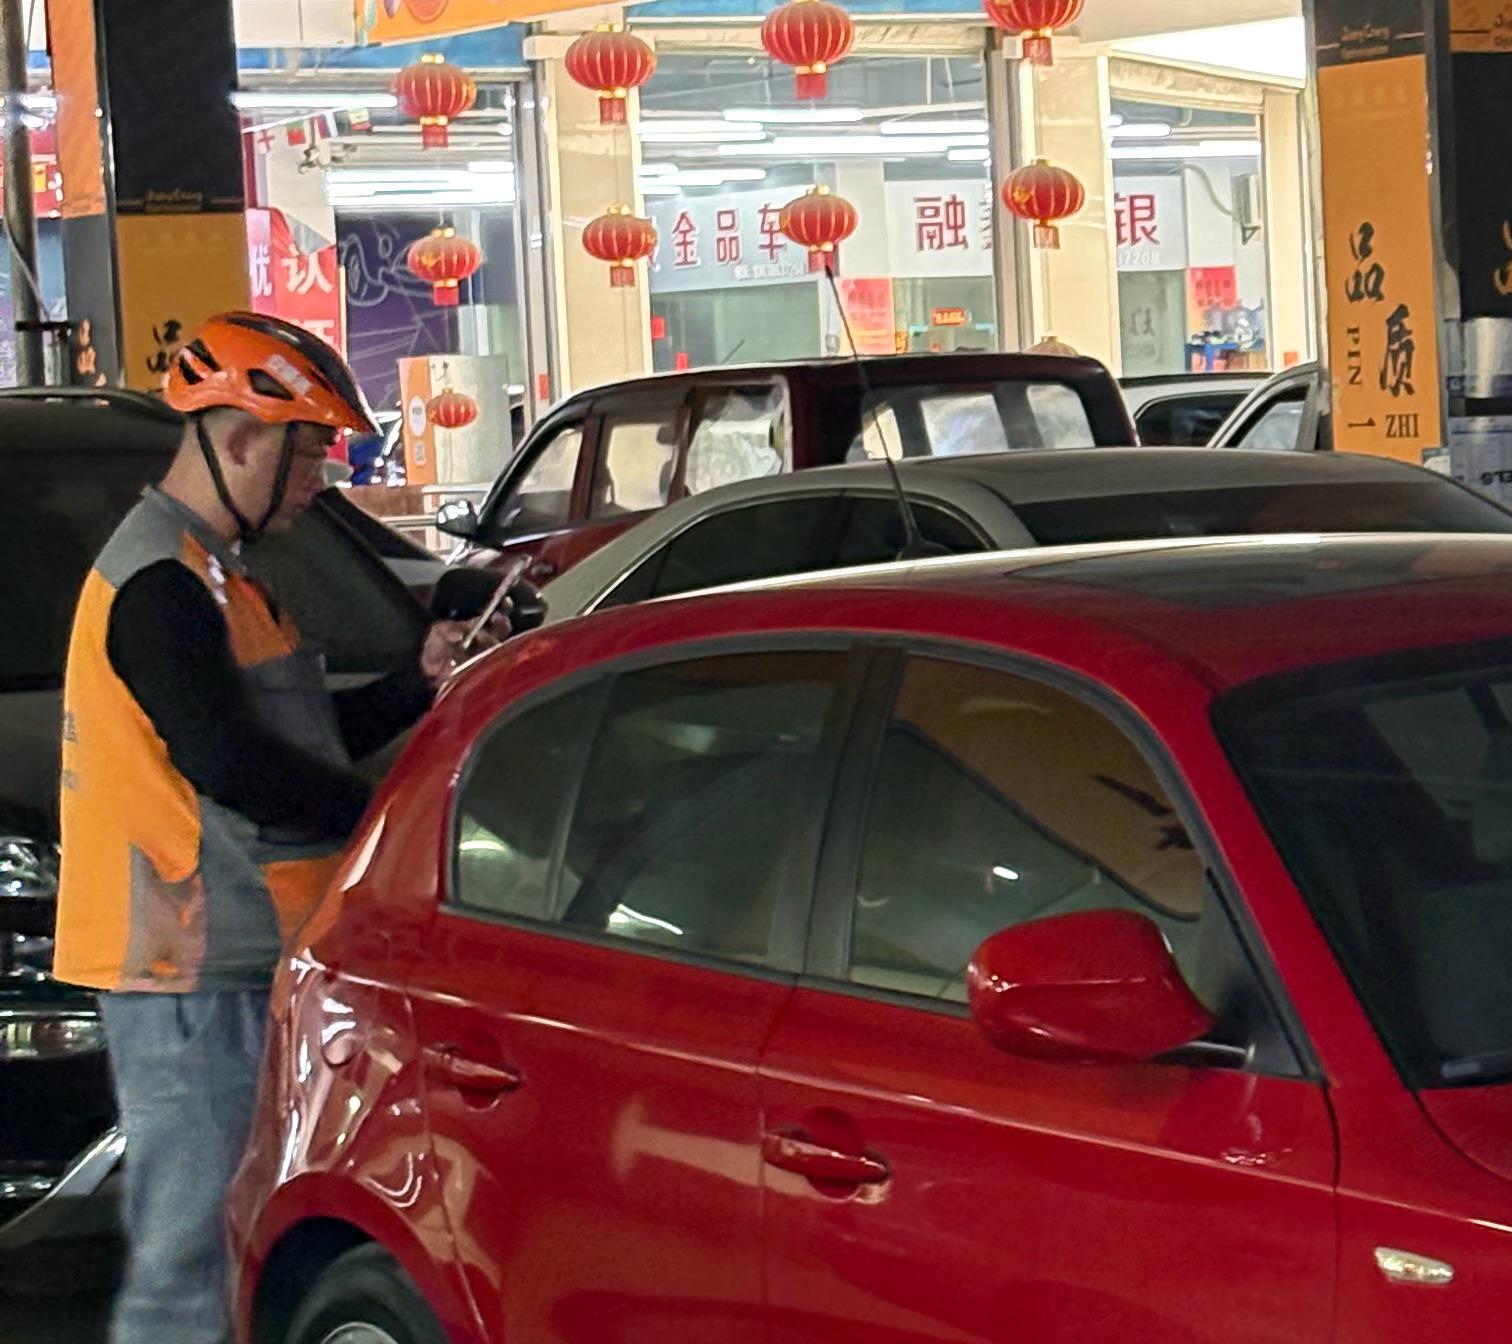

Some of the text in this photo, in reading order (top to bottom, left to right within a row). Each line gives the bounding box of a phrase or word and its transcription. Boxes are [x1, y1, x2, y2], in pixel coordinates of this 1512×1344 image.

[651, 203, 787, 268] 金品车
[913, 194, 969, 251] 融
[1346, 326, 1362, 386] PIN
[1385, 412, 1420, 439] ZHI
